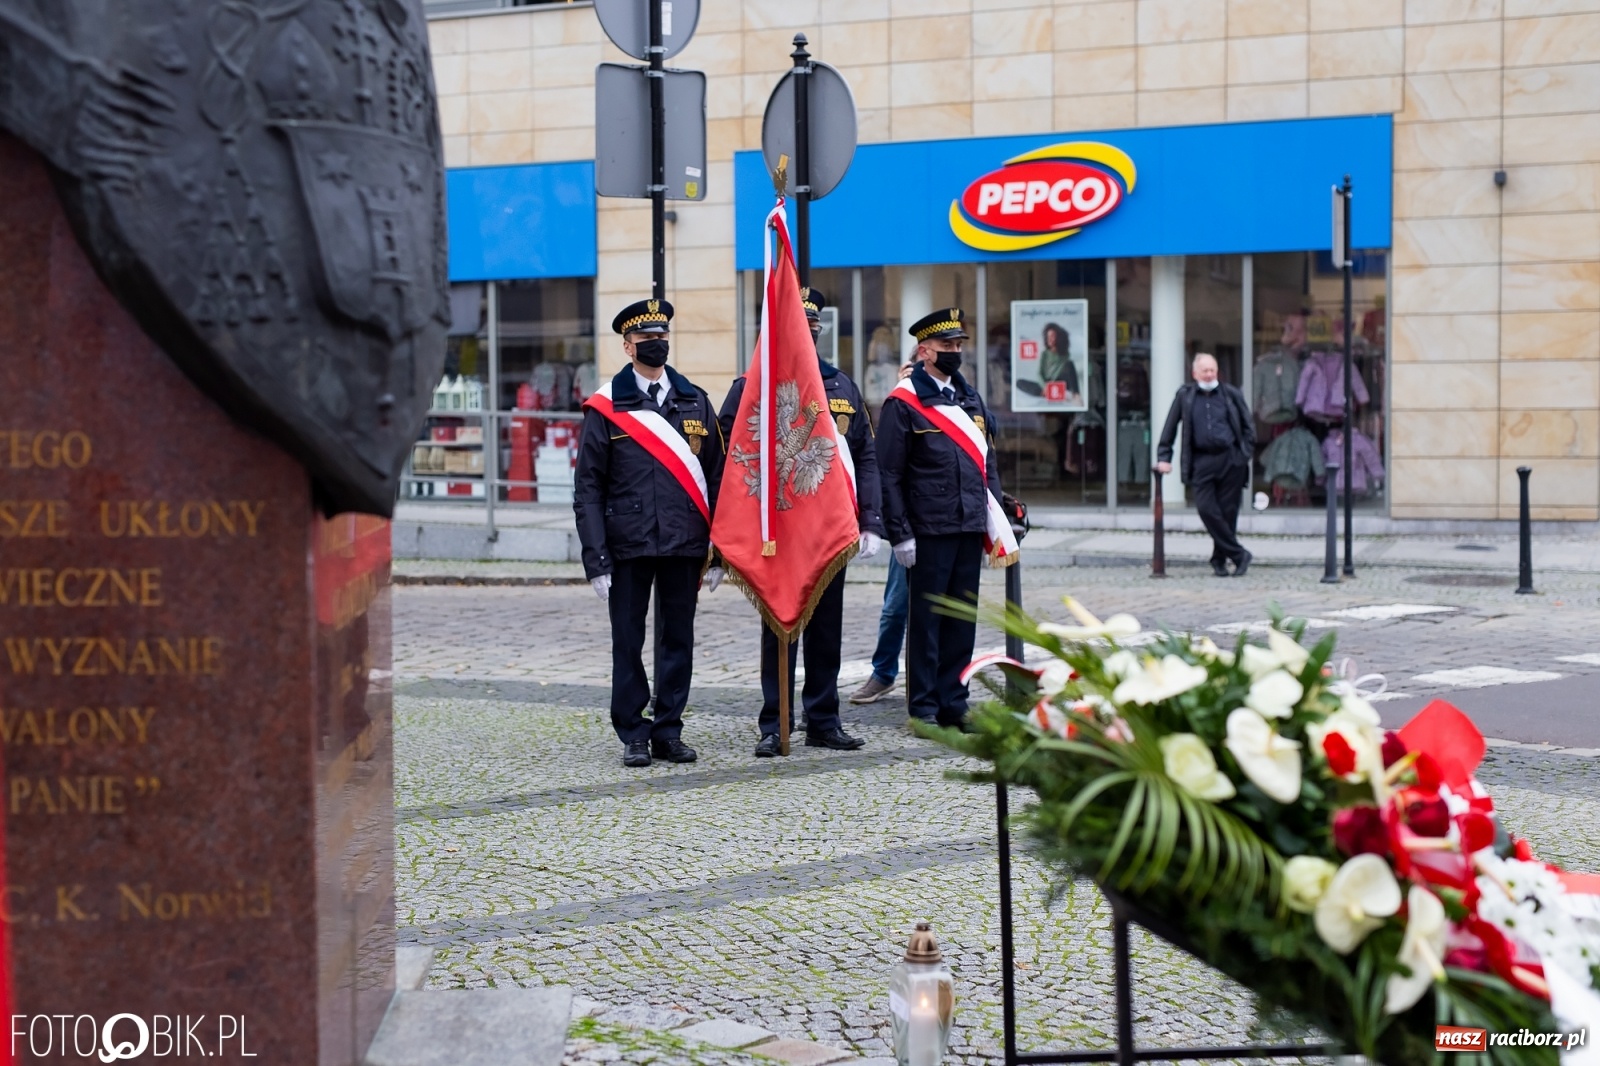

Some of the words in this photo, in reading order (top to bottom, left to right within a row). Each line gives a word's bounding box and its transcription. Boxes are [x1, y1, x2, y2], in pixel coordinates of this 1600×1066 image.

[976, 176, 1107, 216] PEPCO
[101, 499, 264, 538] UKŁONY
[3, 636, 224, 676] WYZNANIE
[55, 884, 101, 922] K.
[117, 880, 272, 922] Norwid
